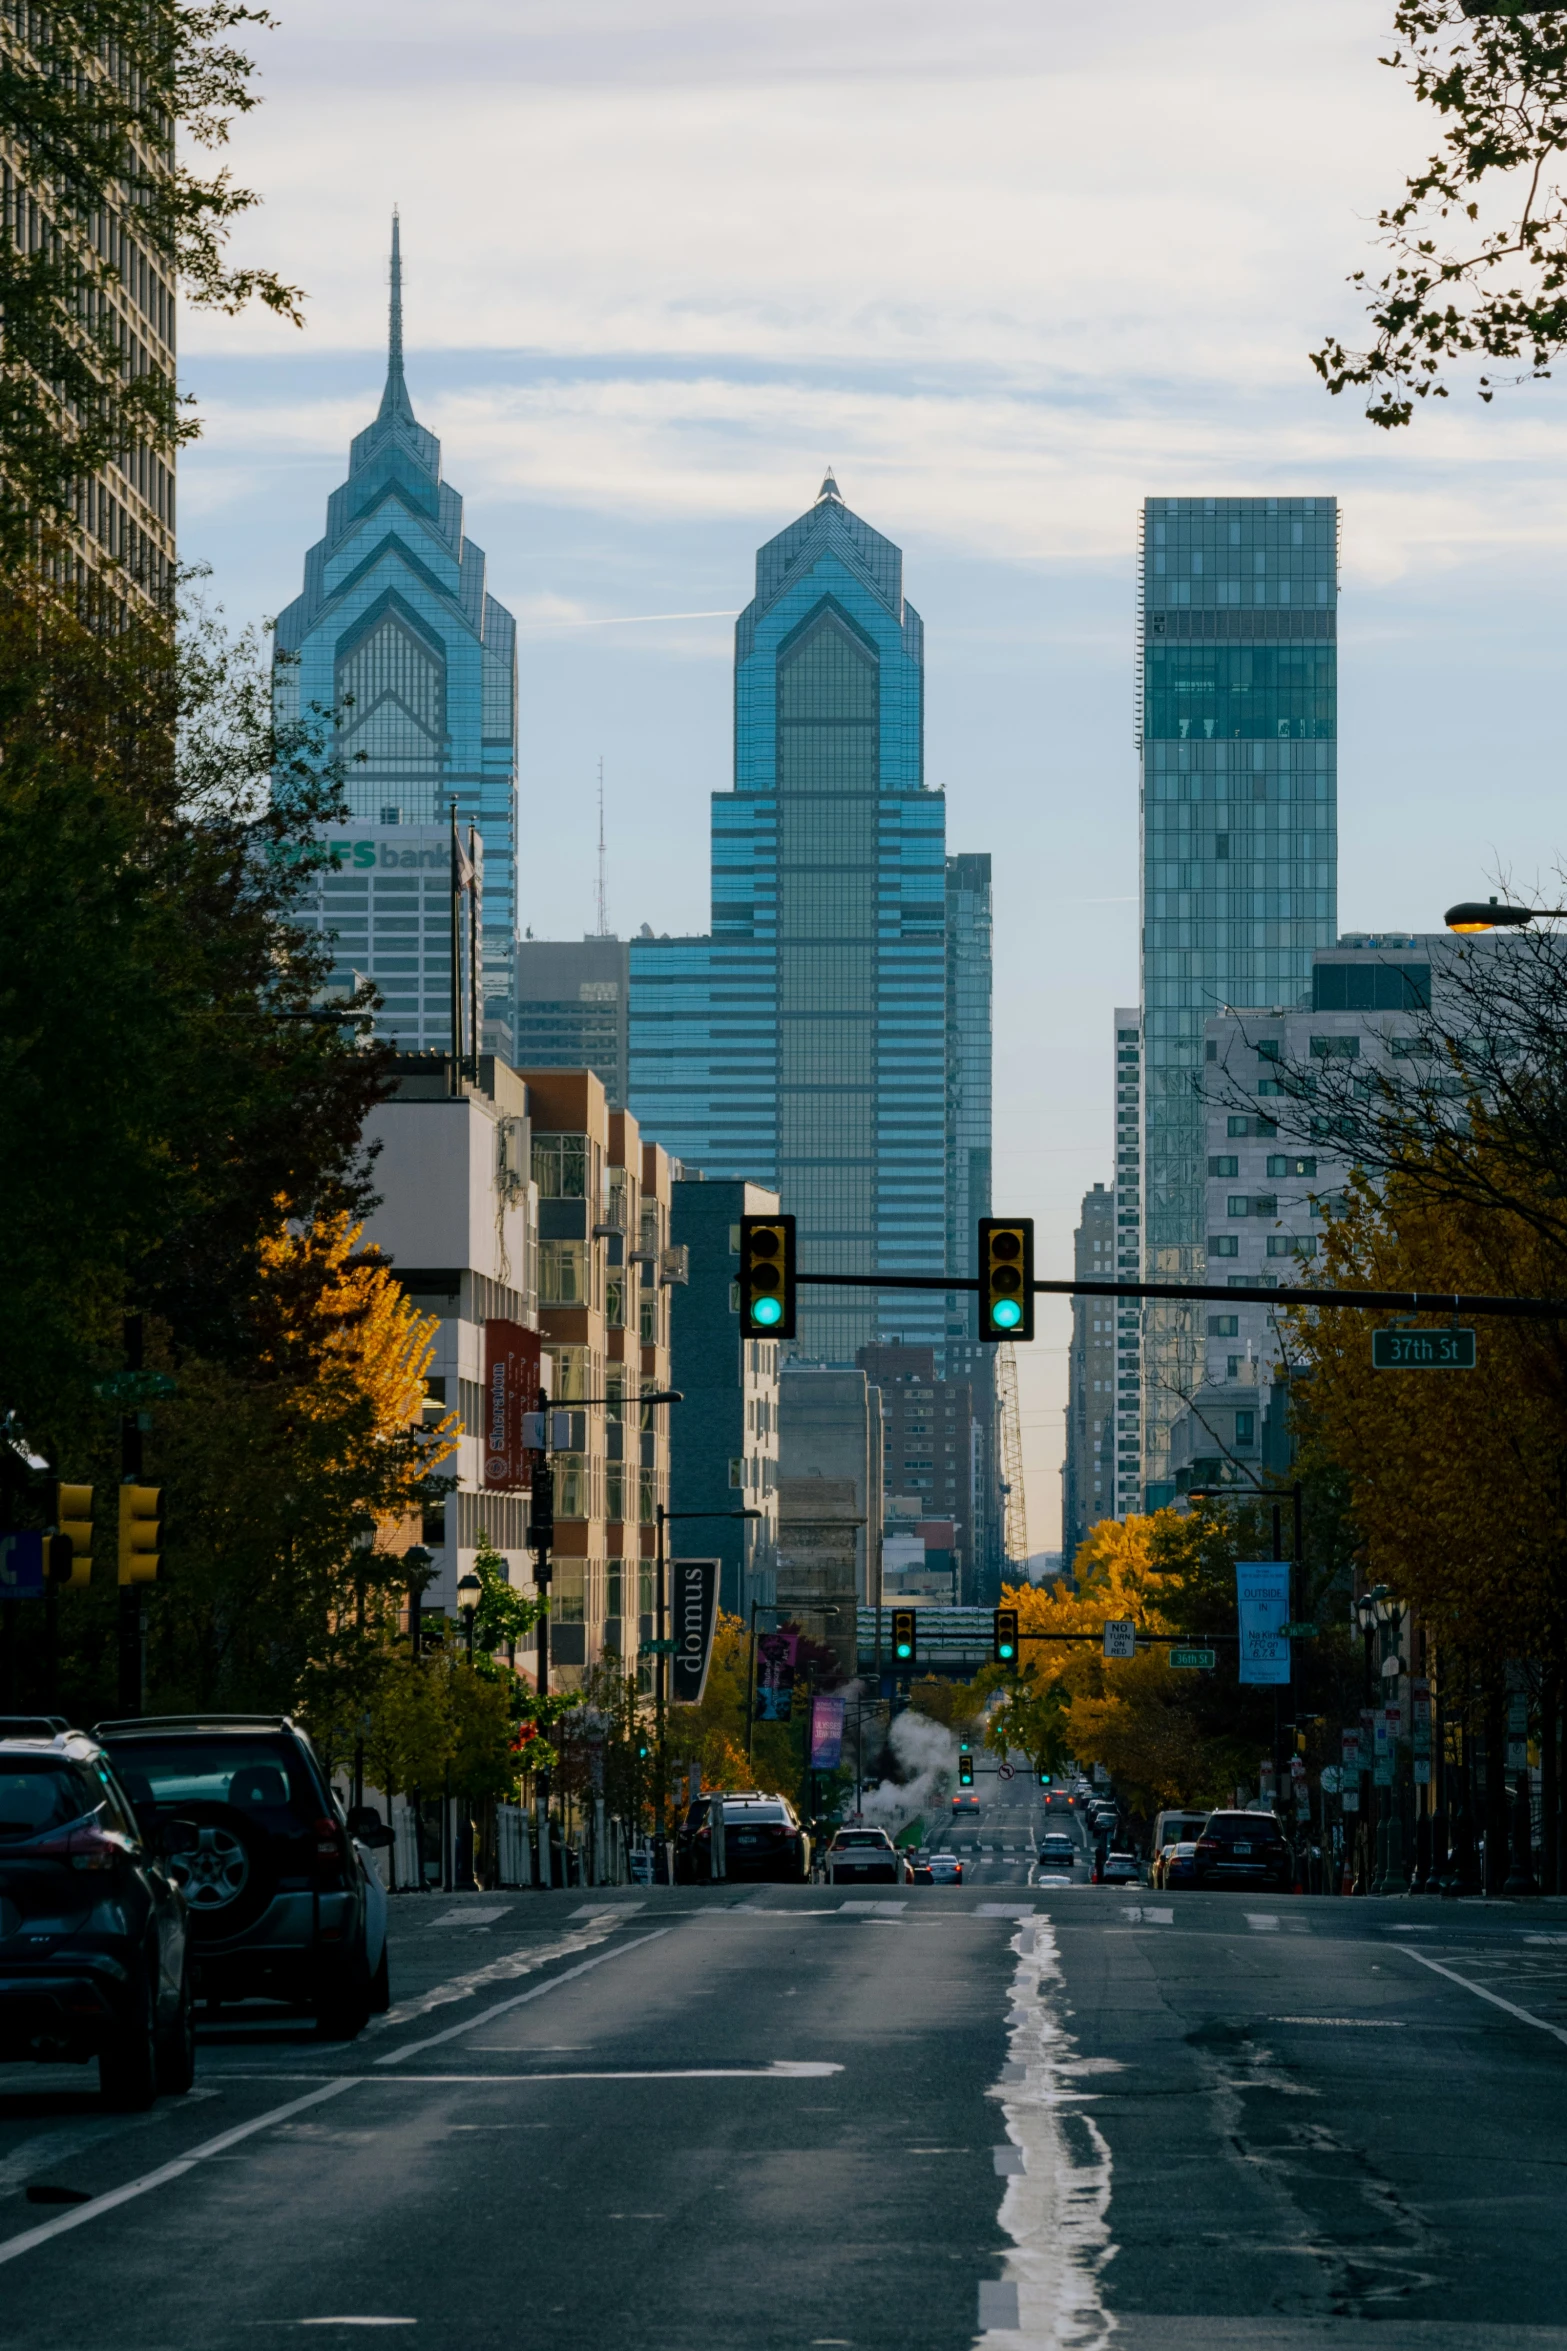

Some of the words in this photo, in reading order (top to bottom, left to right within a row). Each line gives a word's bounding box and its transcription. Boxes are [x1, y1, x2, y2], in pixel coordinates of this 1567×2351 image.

[380, 842, 452, 868] bank
[1390, 1338, 1433, 1360] 37th
[1439, 1338, 1459, 1360] St
[489, 1362, 505, 1451] Sheraton
[1244, 1588, 1283, 1598] OUTSIDE
[1259, 1603, 1268, 1612] IN
[676, 1567, 702, 1673] domus
[1111, 1624, 1128, 1632] NO
[1110, 1633, 1131, 1641] TURN
[1248, 1630, 1261, 1639] Na
[1263, 1630, 1279, 1639] Kim
[1249, 1640, 1266, 1649] FFC
[781, 1649, 789, 1660] Art
[1177, 1654, 1197, 1664] 36th
[1199, 1654, 1208, 1664] St
